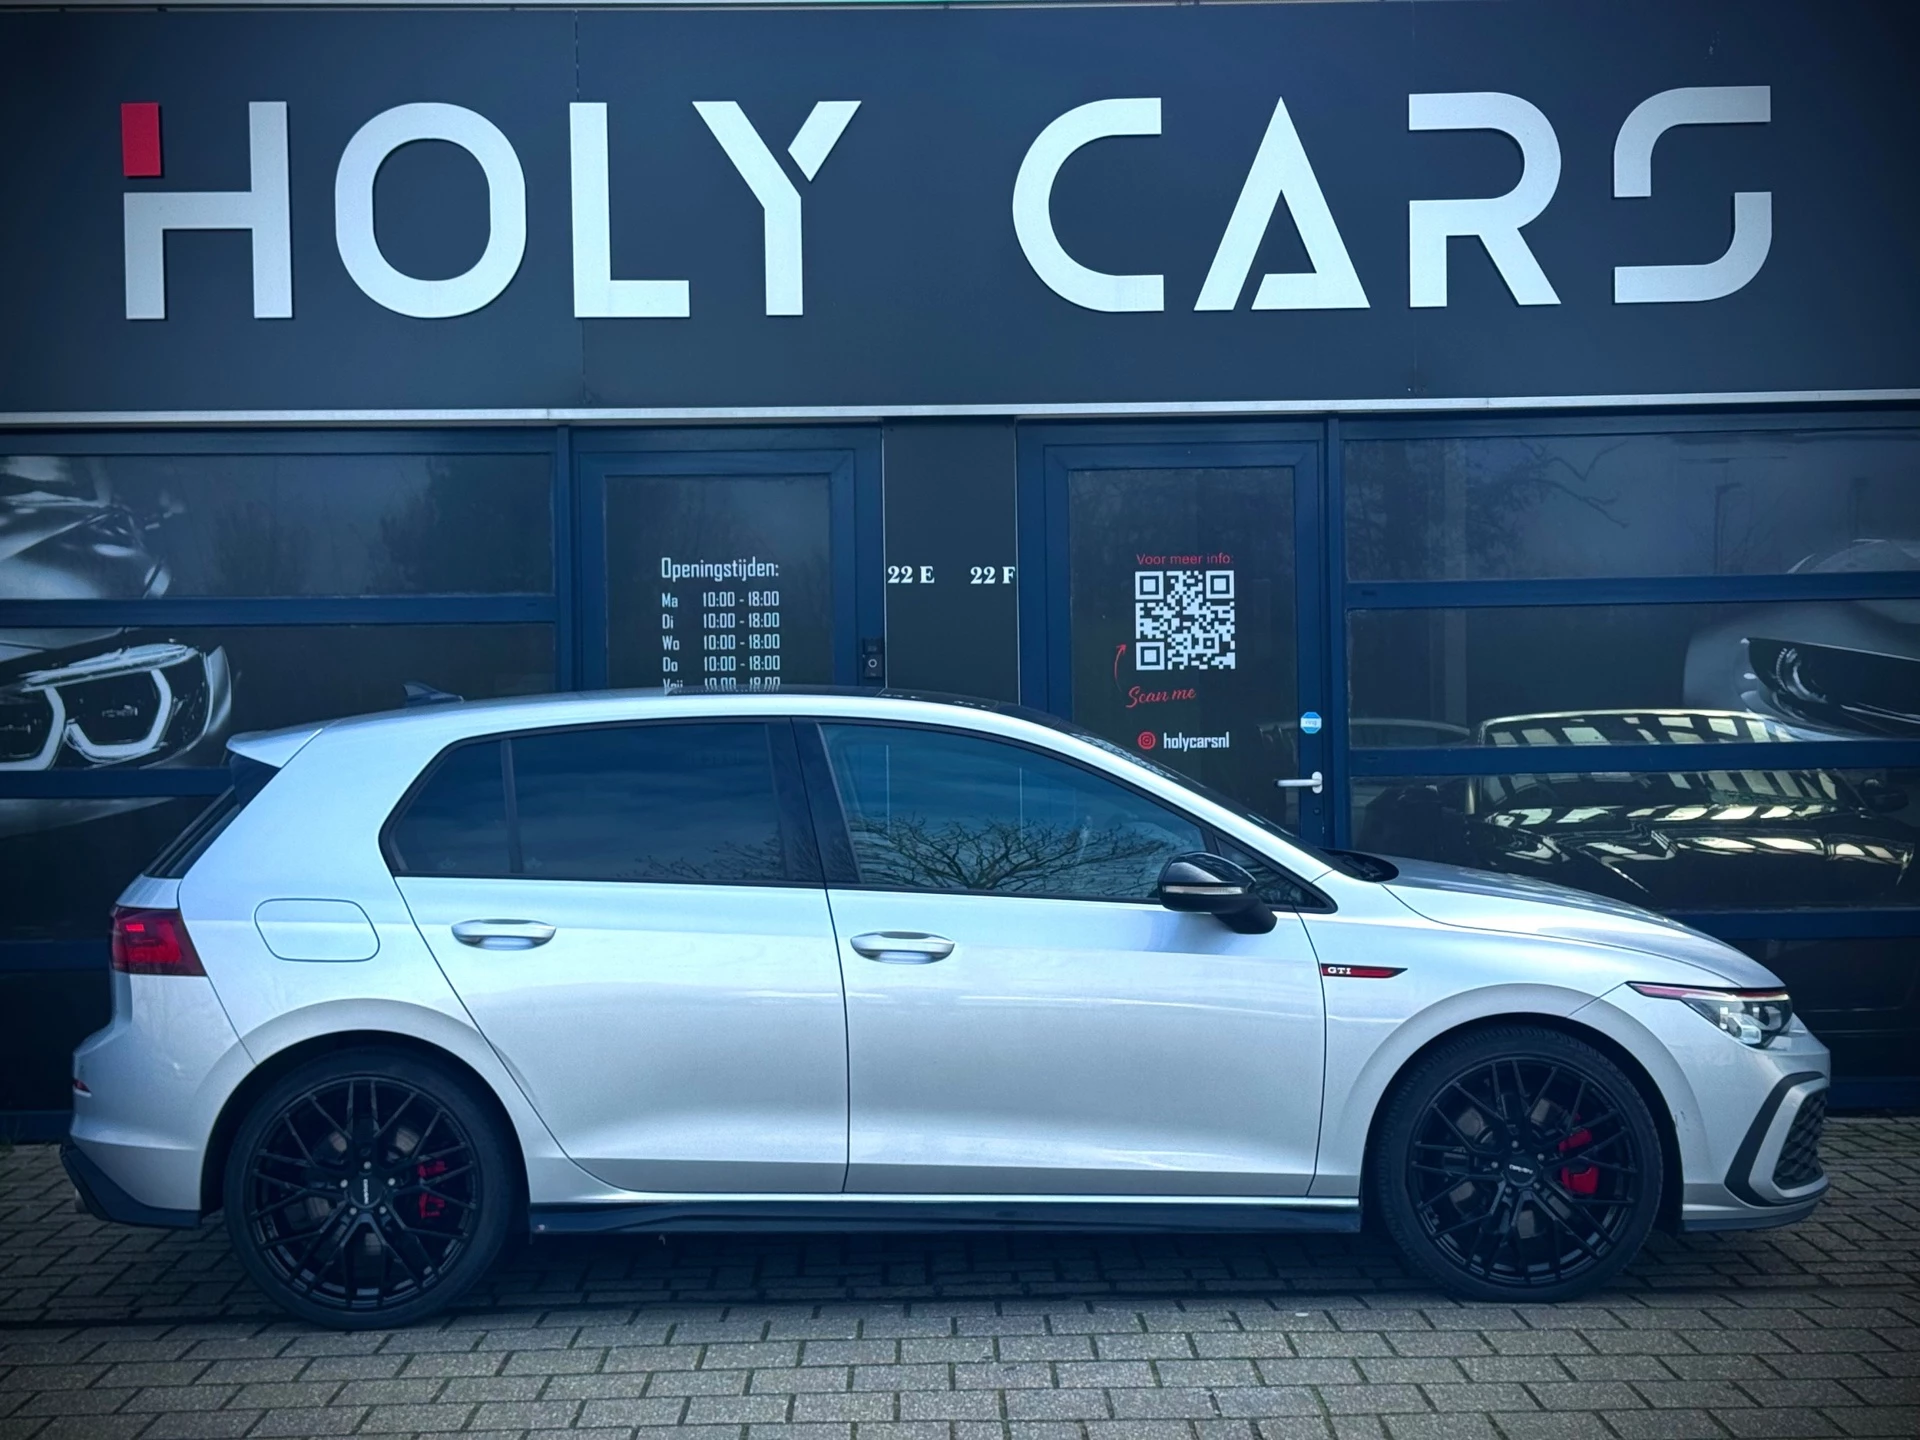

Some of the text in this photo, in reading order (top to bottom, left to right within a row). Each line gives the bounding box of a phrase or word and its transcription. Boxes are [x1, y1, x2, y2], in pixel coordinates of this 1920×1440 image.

[120, 85, 1773, 321] HOLY CARS
[1136, 552, 1235, 565] Voor meer info:
[661, 556, 780, 583] Openingstijden:
[887, 565, 935, 584] 22 E
[970, 566, 1016, 585] 22 F
[661, 593, 679, 608] Ma
[703, 591, 736, 608] 10:00
[748, 590, 780, 607] 18:00
[662, 614, 674, 629] Di
[703, 613, 736, 629] 10:00
[748, 612, 780, 628] 18:00
[662, 635, 680, 651] Wo
[704, 634, 736, 650] 10:00
[749, 633, 780, 649] 18:00
[662, 656, 678, 672] Do
[704, 656, 736, 672] 10:00
[749, 654, 781, 671] 18:00
[1126, 686, 1197, 708] Scan me
[1163, 731, 1230, 752] holycarsnl
[1327, 966, 1352, 975] GTI
